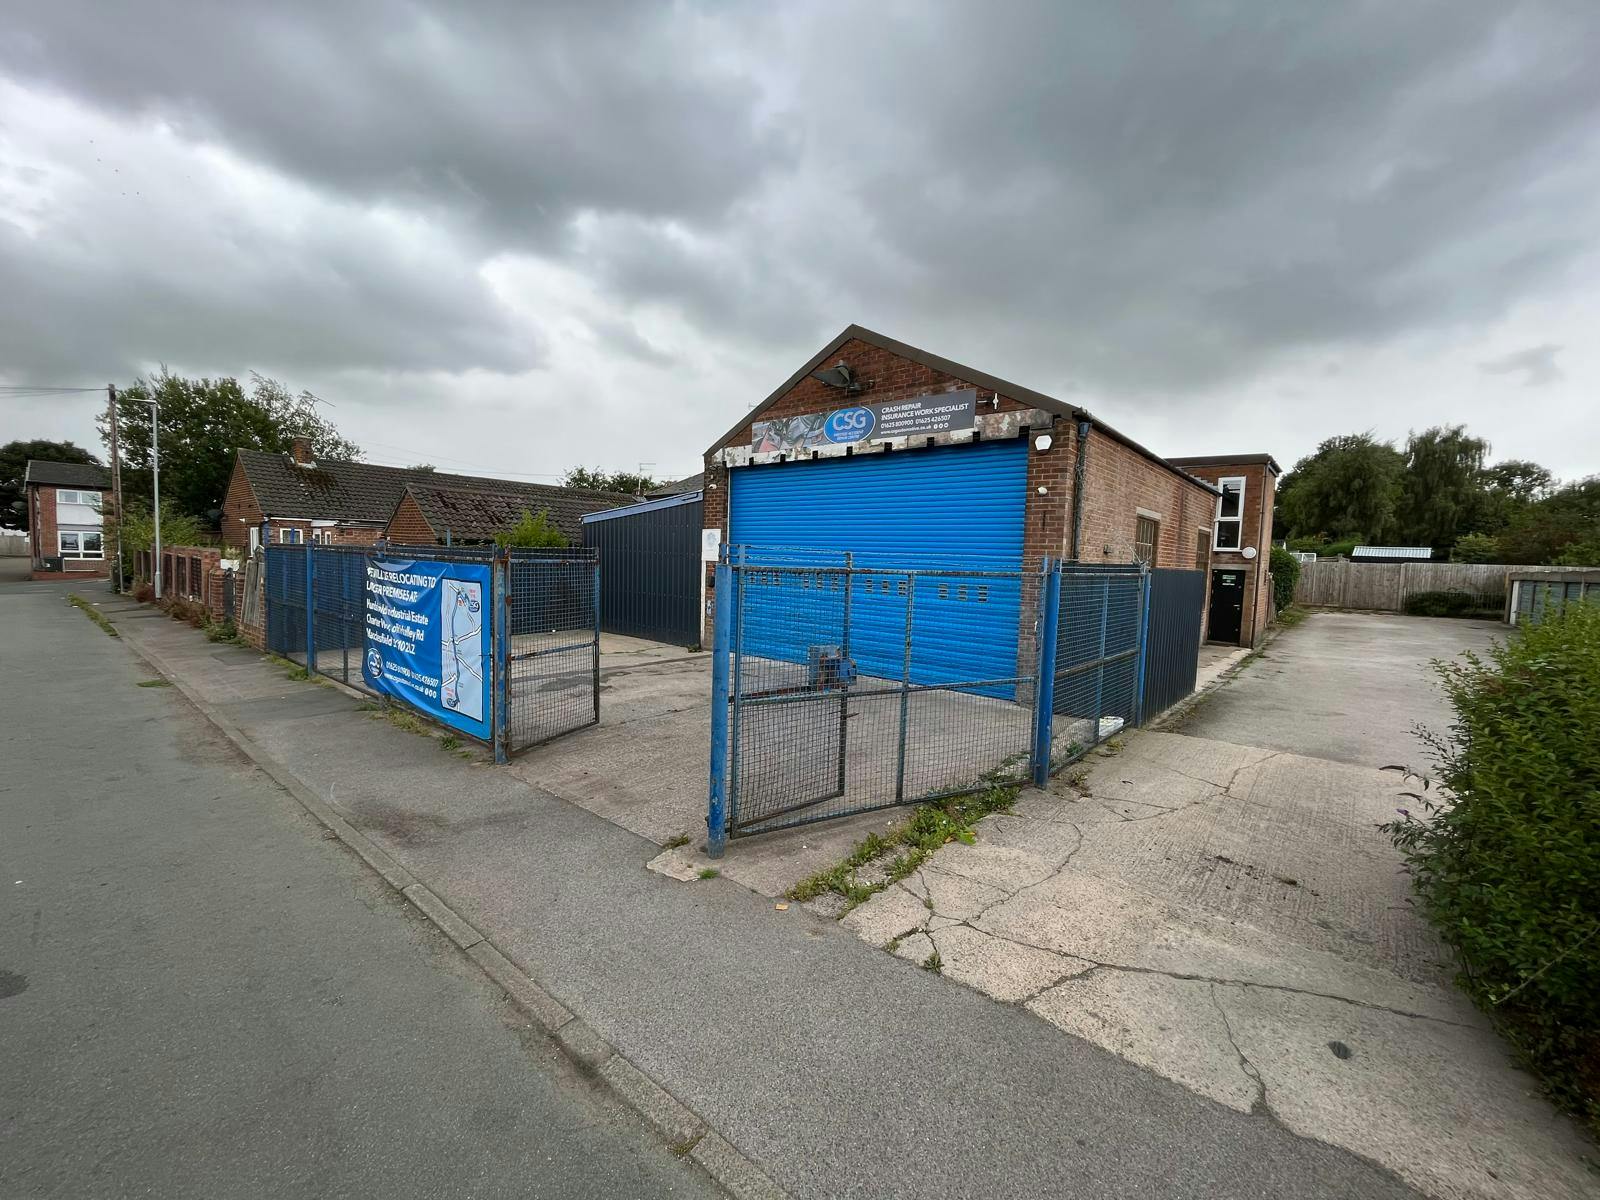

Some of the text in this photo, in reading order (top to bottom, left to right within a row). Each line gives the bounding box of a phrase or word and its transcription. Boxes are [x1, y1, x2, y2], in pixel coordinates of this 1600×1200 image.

[881, 402, 922, 414] CRASH REPAIR
[881, 403, 969, 421] INSURANCE WORK SPECIALIST
[832, 410, 866, 432] CSG
[880, 421, 895, 429] 01625
[915, 417, 931, 425] 01625
[931, 414, 951, 422] 426507
[427, 576, 437, 589] TO
[411, 611, 429, 626] Estate
[415, 629, 425, 641] Rd
